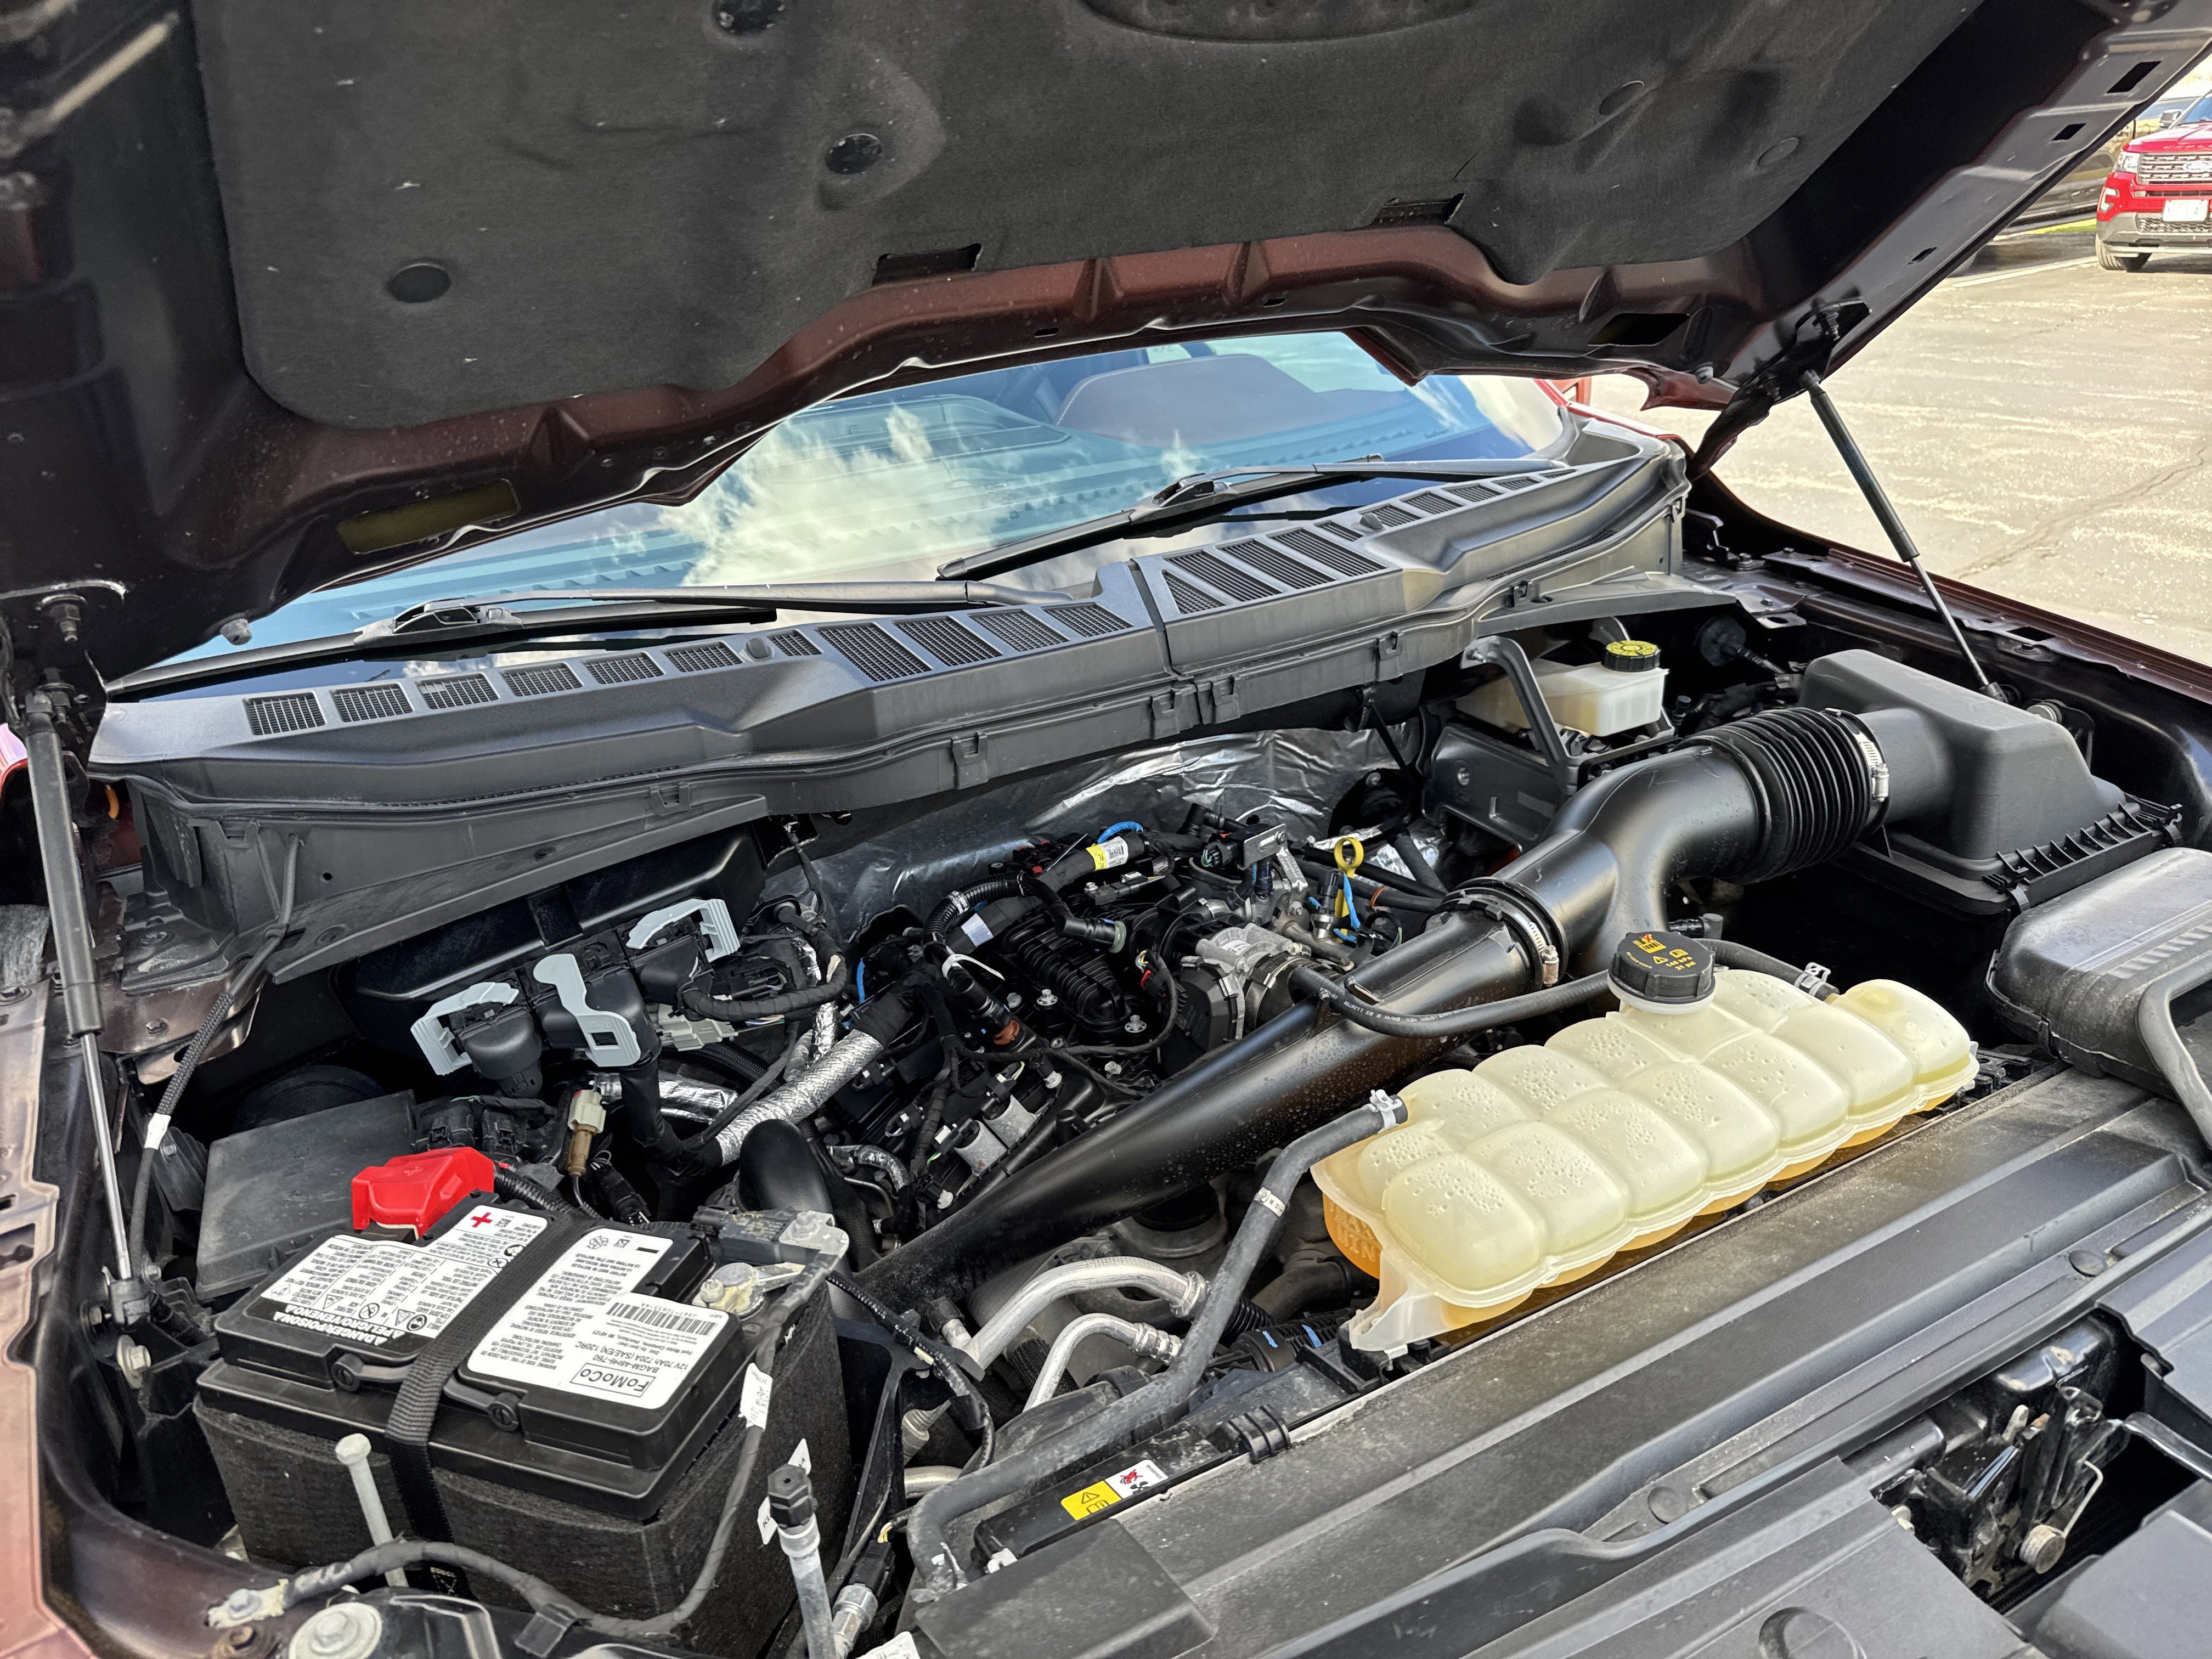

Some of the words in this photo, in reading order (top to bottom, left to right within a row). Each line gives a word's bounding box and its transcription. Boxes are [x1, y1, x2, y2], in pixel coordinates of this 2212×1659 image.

[575, 1341, 600, 1351] 120RC
[593, 1355, 659, 1373] BAGM-48H6-760
[635, 1355, 654, 1364] 720A
[654, 1359, 674, 1368] 70Ah
[580, 1369, 650, 1392] FoMoCo
